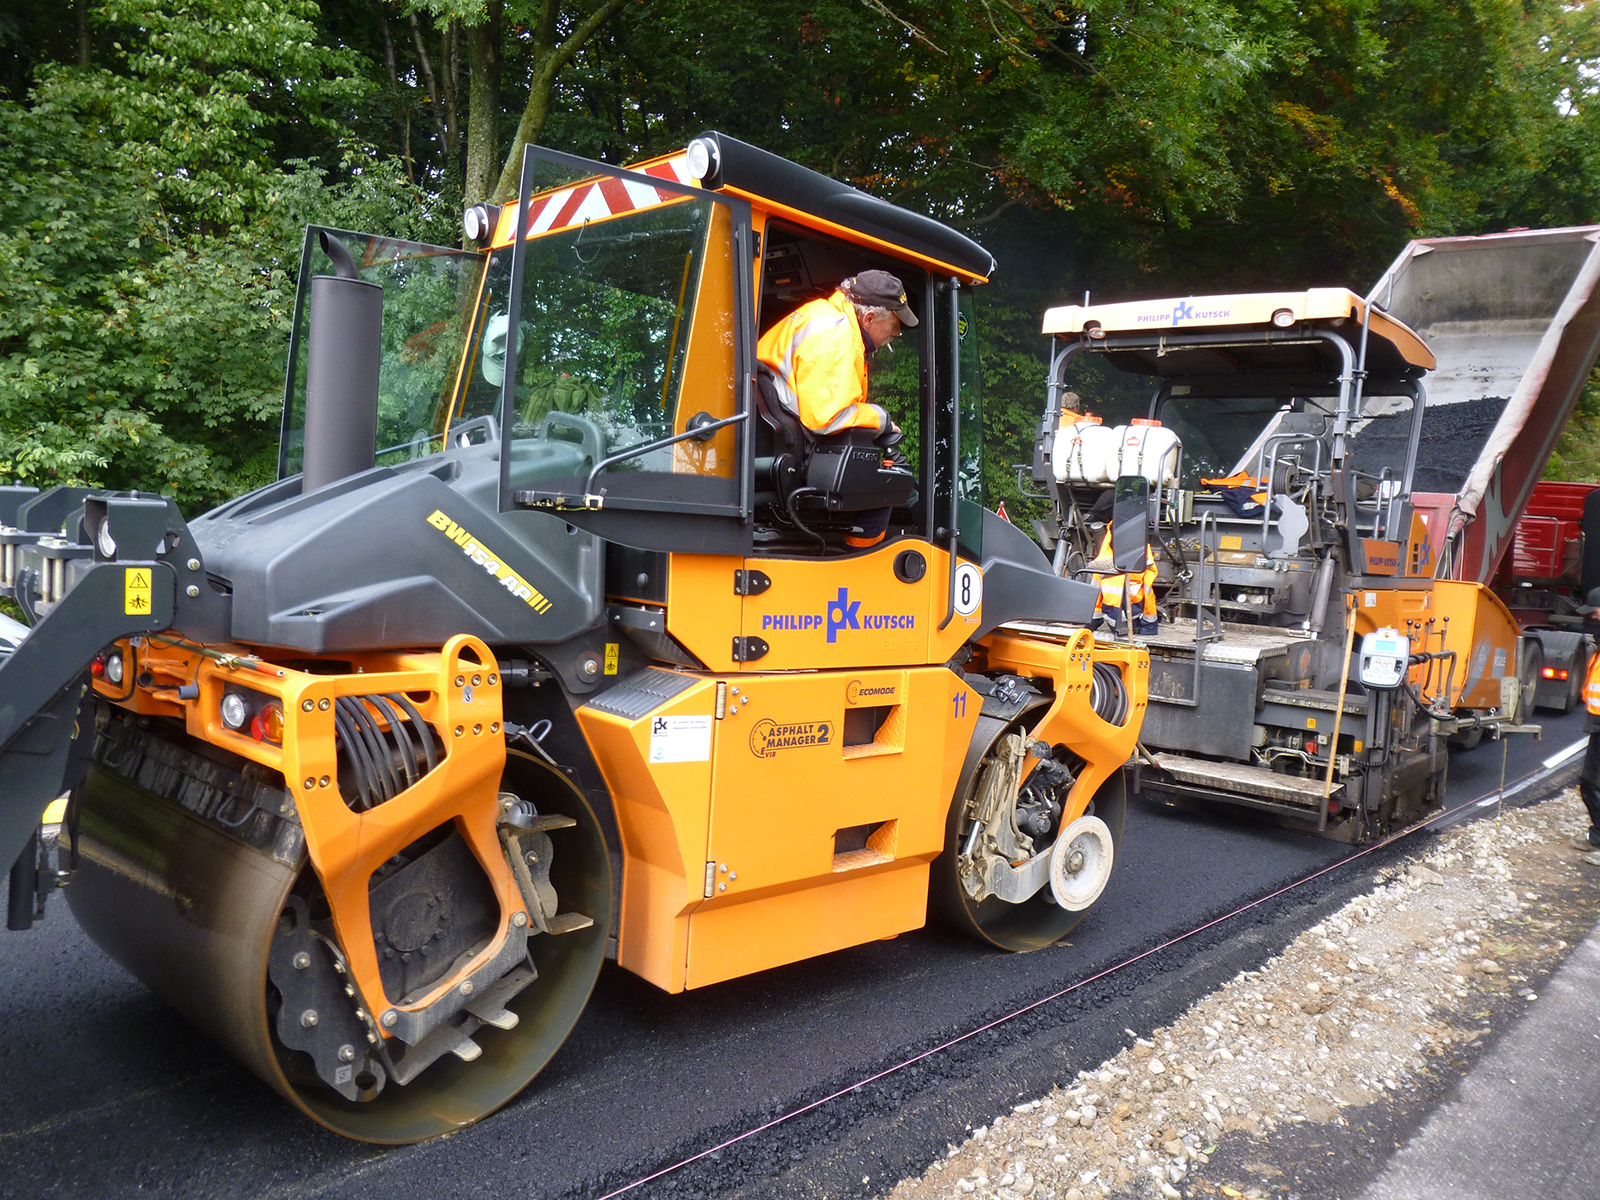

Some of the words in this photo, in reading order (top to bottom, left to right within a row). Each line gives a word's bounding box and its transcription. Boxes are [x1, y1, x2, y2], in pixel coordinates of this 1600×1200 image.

[1137, 314, 1171, 322] PHILIPP
[1195, 310, 1230, 319] KUTSCH
[426, 509, 473, 548] BW
[463, 542, 502, 576] 154
[499, 575, 532, 600] AP
[962, 573, 970, 606] 8
[762, 614, 823, 630] PHILIPP
[863, 614, 915, 629] KUTSCH
[859, 687, 895, 696] ECOMODE
[952, 691, 967, 719] 11
[768, 724, 814, 737] ASPHALT
[817, 724, 829, 743] 2
[766, 735, 816, 748] MANAGER
